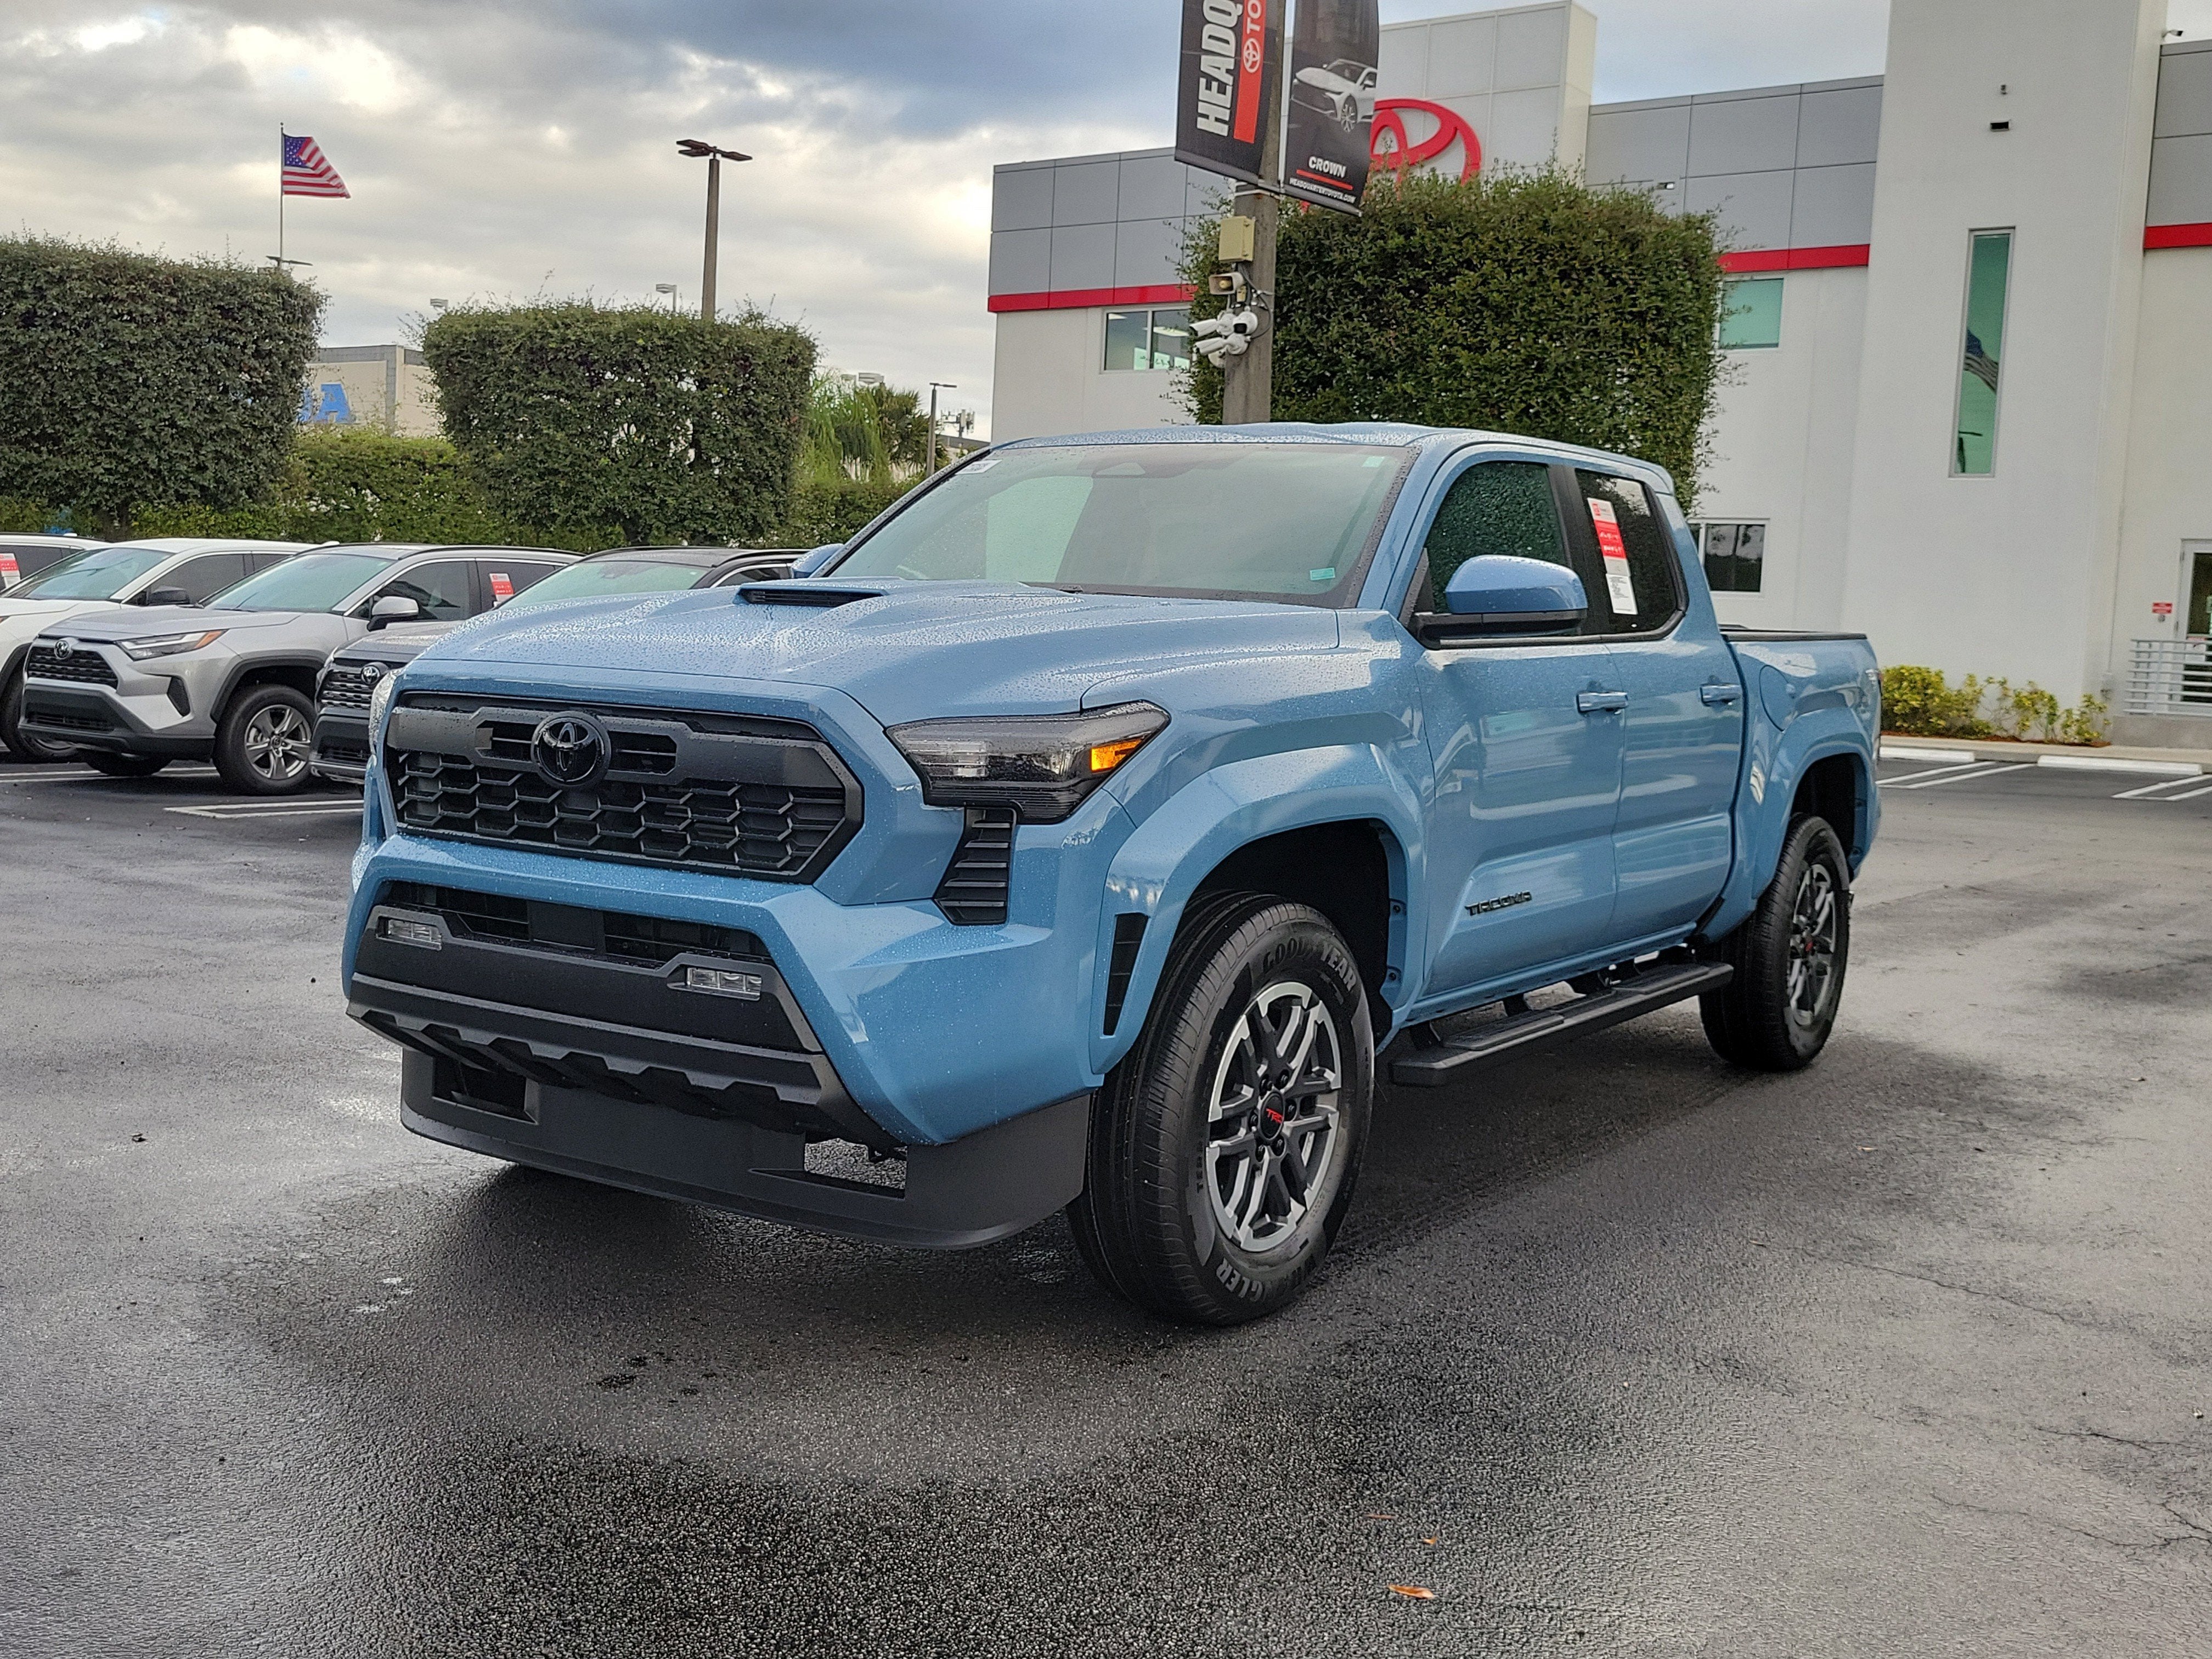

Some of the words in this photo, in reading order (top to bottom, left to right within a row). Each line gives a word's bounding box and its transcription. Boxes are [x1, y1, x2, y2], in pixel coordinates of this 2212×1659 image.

[1309, 156, 1346, 178] CROWN
[1465, 890, 1532, 916] TACOMA
[1266, 1108, 1283, 1124] TRD
